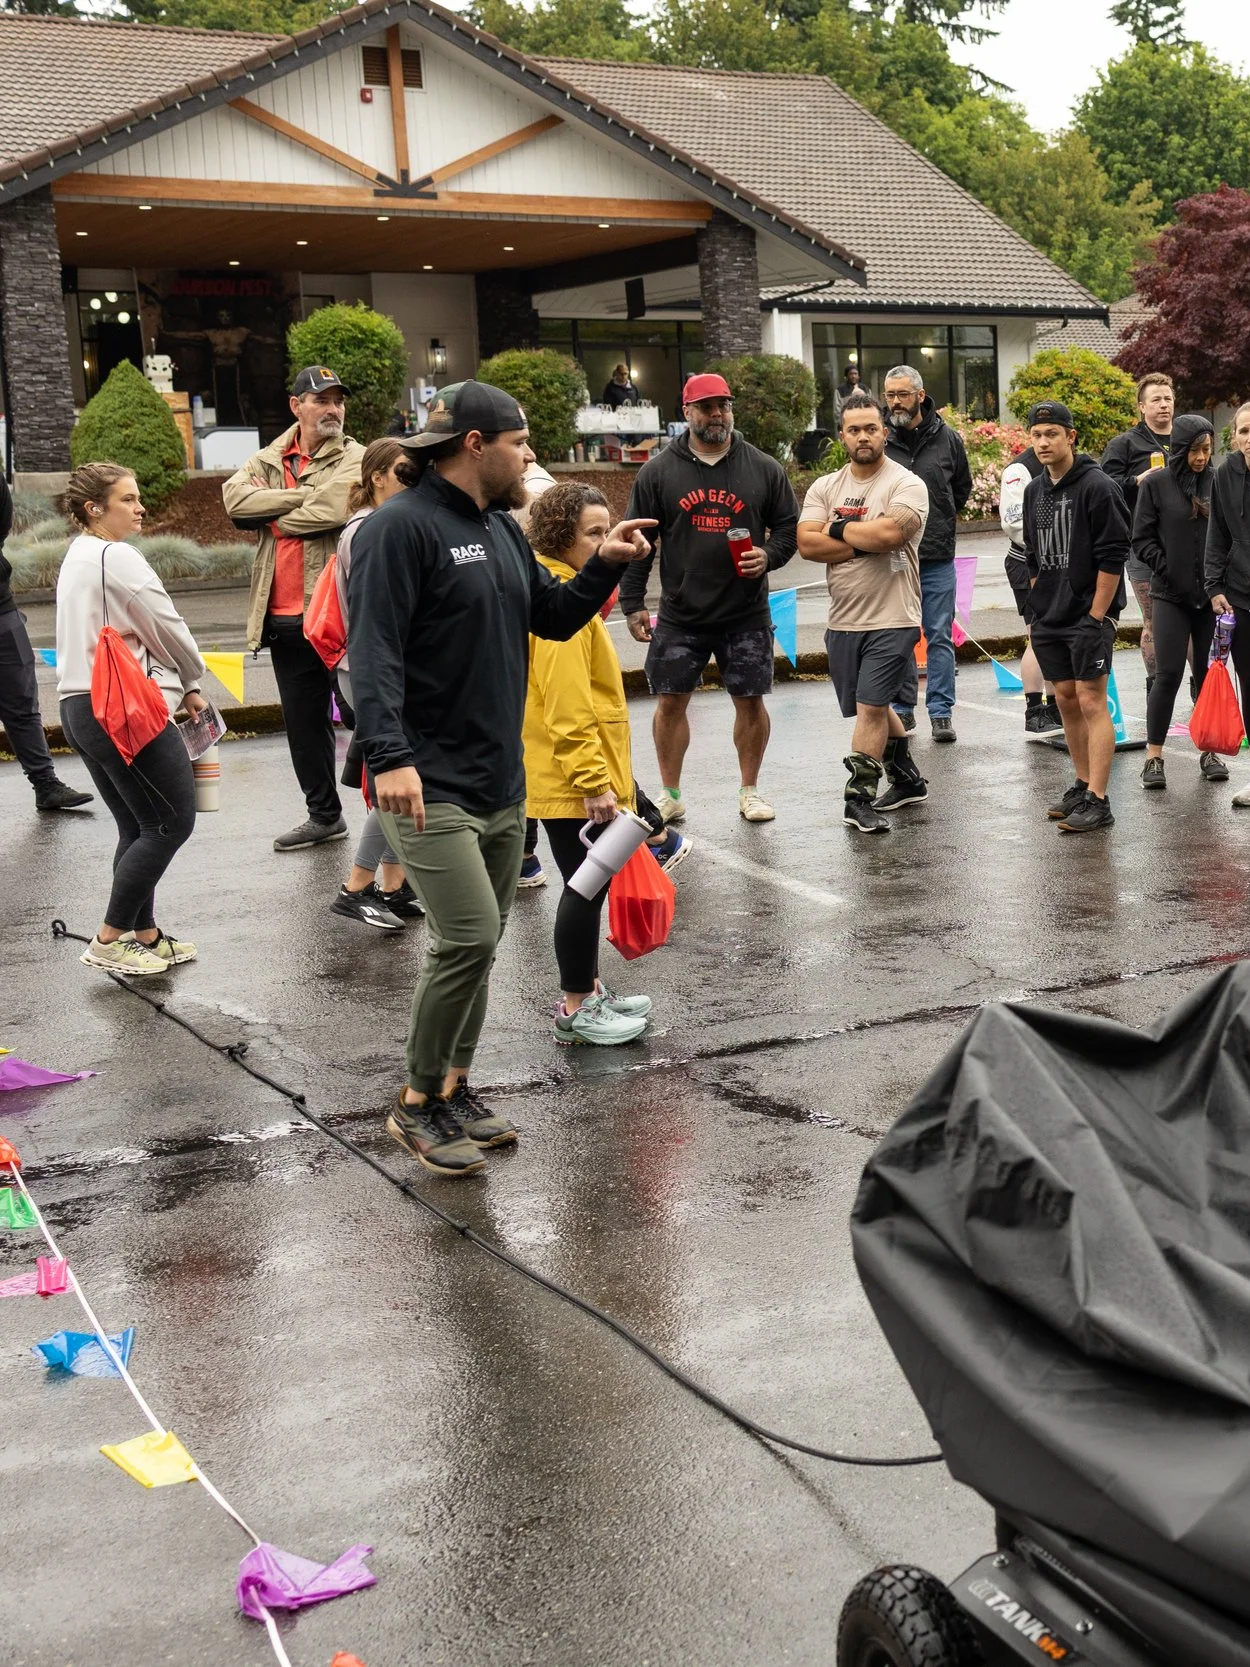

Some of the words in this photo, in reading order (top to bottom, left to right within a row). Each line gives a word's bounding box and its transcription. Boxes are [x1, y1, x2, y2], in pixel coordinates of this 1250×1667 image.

[679, 488, 746, 514] DUNGEON
[692, 515, 731, 528] FITNESS
[450, 544, 486, 560] RACC
[985, 1590, 1051, 1645] TANK
